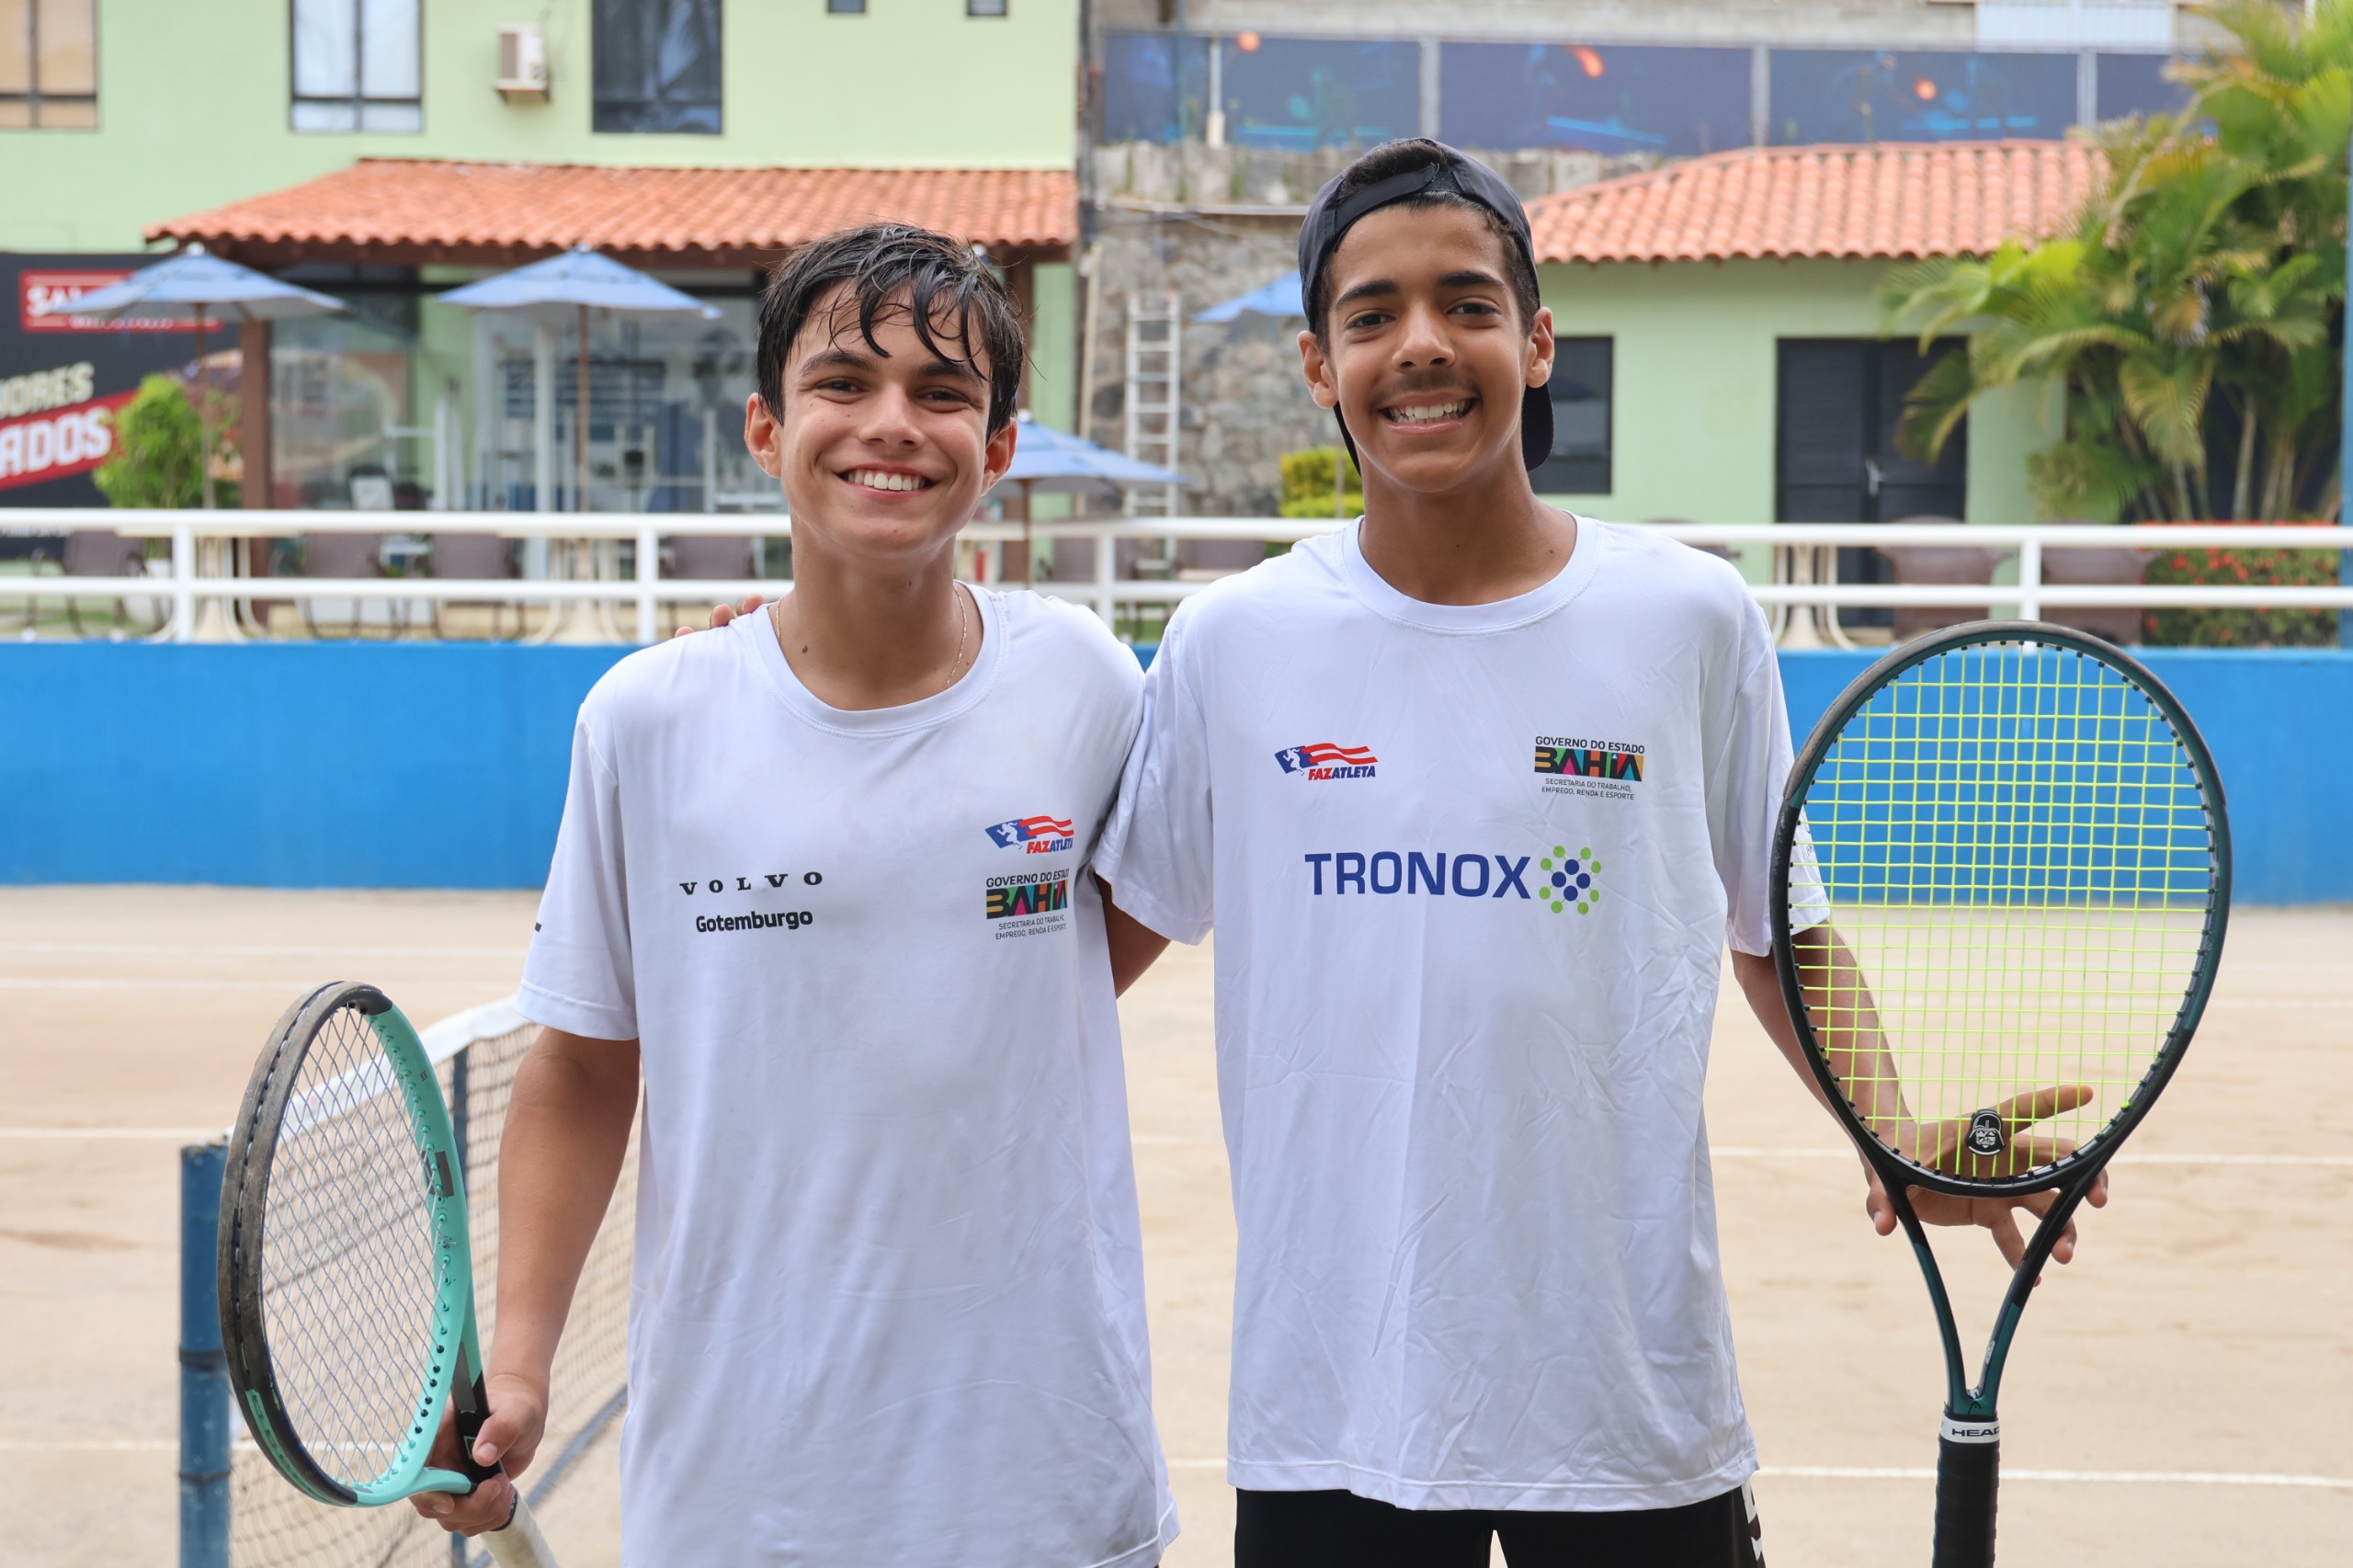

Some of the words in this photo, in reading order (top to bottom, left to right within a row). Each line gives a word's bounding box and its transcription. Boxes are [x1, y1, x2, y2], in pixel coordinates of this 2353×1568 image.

[0, 361, 95, 419] ORES
[1535, 735, 1587, 748] GOVERNO
[1590, 740, 1606, 750] DO
[1608, 742, 1645, 754] ESTADO
[1534, 745, 1643, 782] BAHIA
[1545, 778, 1586, 787] SECRETARIA
[1586, 780, 1597, 789] DO
[1597, 781, 1631, 792] TRABALHO,
[1576, 789, 1598, 797] RENDA
[1606, 791, 1634, 801] ESPORTE
[679, 871, 823, 895] VOLVO
[986, 872, 1039, 888] GOVERNO
[1040, 871, 1052, 882] DO
[1304, 851, 1531, 900] TRONOX
[986, 880, 1068, 919] BAHIA
[696, 911, 813, 933] Gotemburgo
[998, 919, 1036, 930] SECRETARIA
[1036, 917, 1044, 926] DO
[995, 929, 1028, 940] EMPREGO,
[1028, 926, 1047, 937] RENDA
